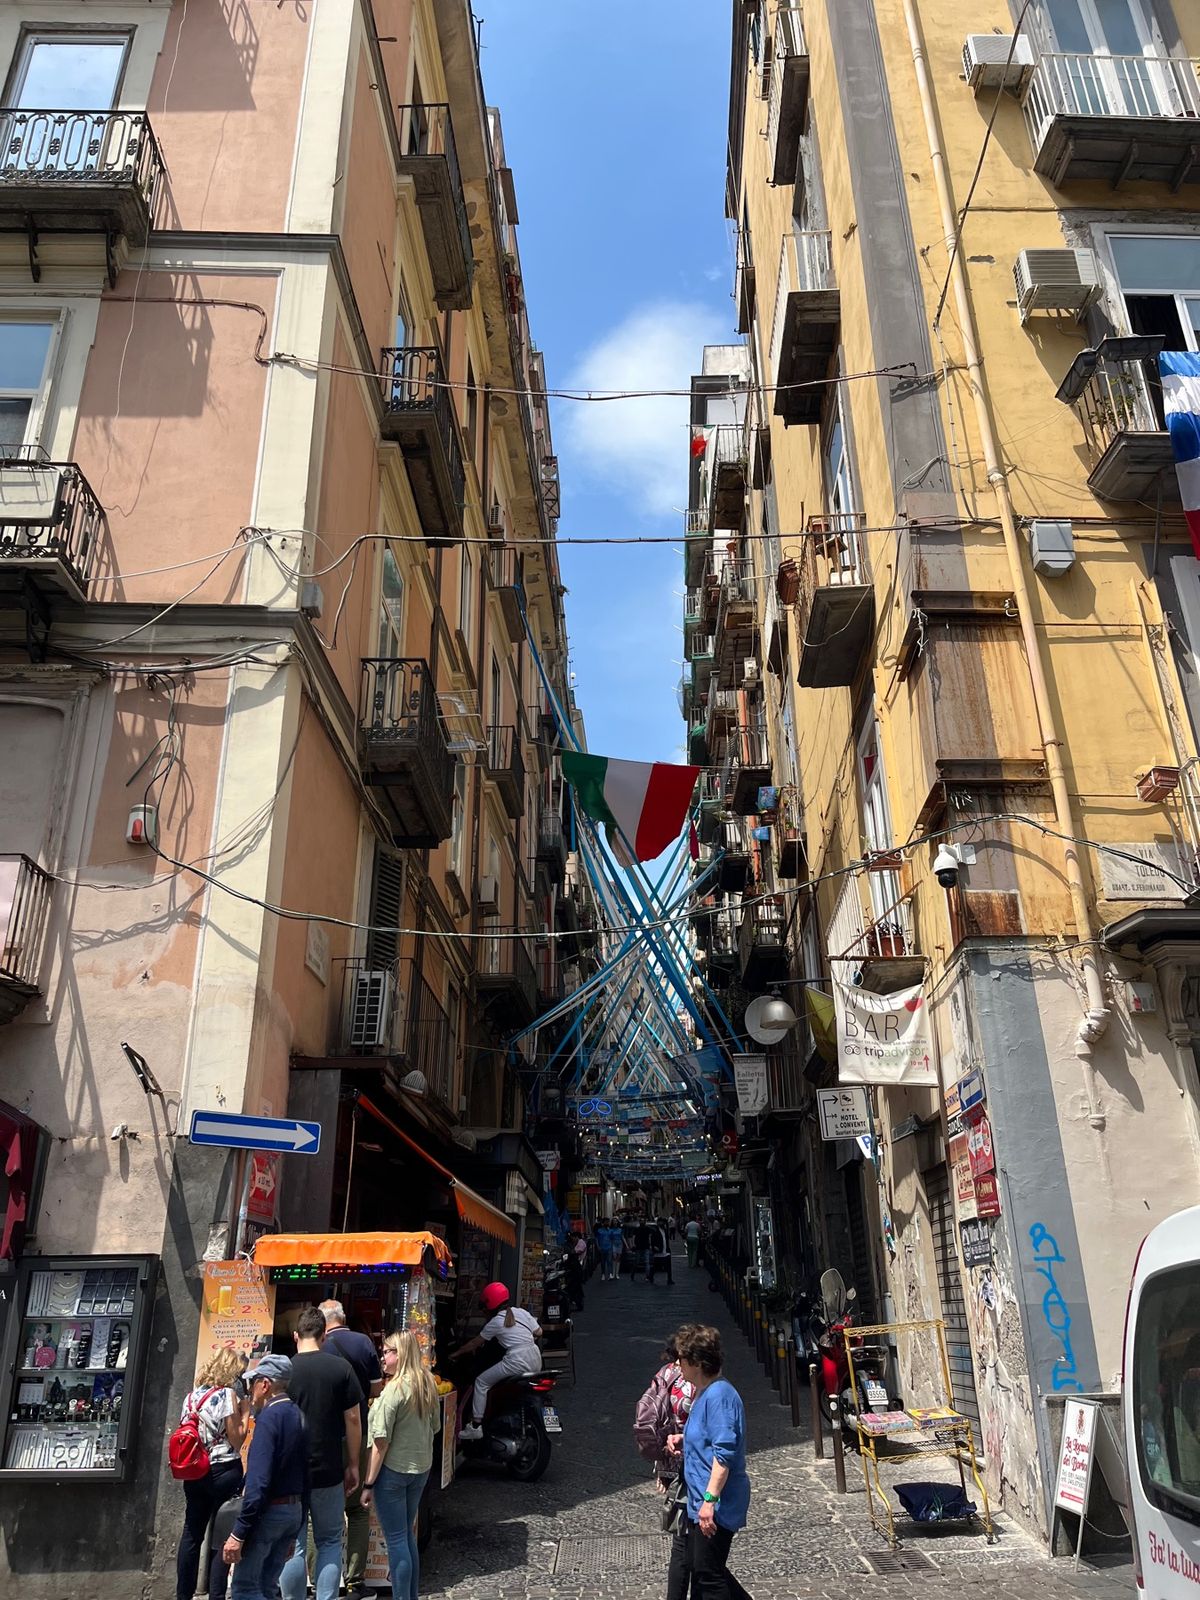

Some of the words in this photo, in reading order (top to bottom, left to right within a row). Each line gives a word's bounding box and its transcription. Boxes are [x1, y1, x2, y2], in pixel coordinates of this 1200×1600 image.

[1138, 849, 1154, 859] VIA
[1134, 864, 1167, 878] TOLEDO
[841, 986, 901, 1012] WINE
[844, 1010, 901, 1041] BAR
[864, 1045, 926, 1059] tripadvisor
[241, 1304, 270, 1314] 2.50
[1167, 1543, 1181, 1573] la
